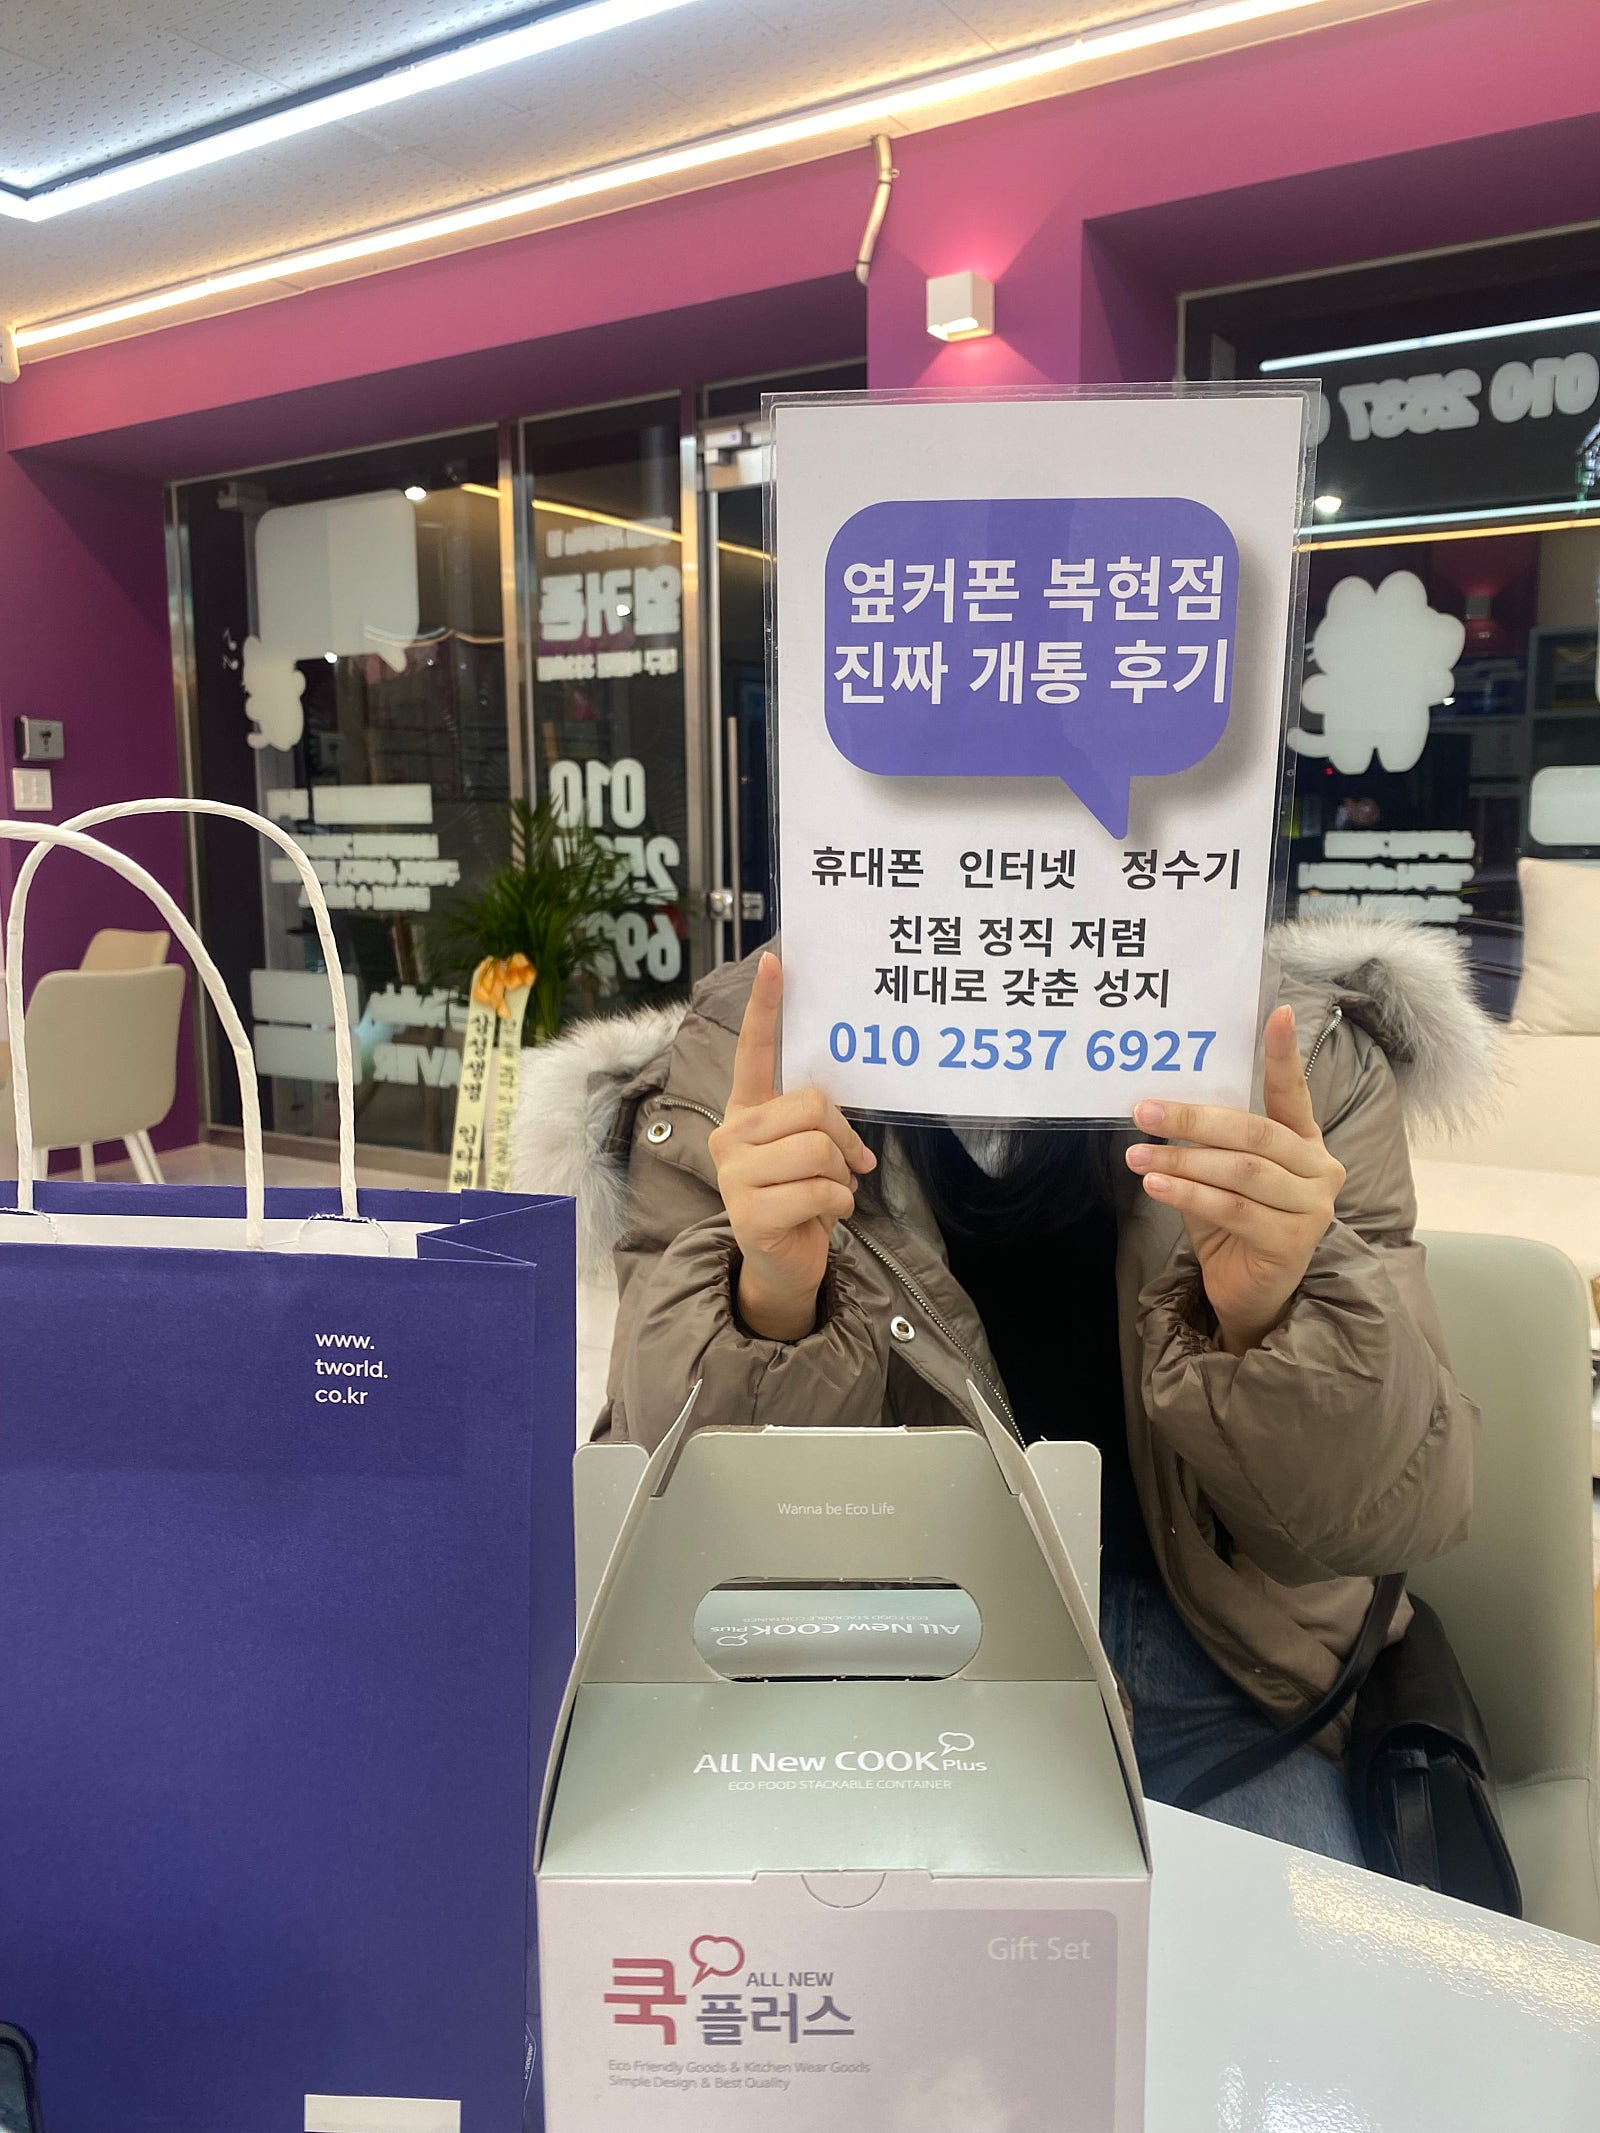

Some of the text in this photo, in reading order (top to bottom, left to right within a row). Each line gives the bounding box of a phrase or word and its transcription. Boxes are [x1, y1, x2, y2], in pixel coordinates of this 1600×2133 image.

[843, 555, 1225, 624] 옆커폰 복현점
[834, 638, 1228, 705] 진짜 개통 후기
[811, 846, 1241, 890] 휴대폰 인터넷 정수기
[889, 914, 1147, 958] 친절 정직 저렴
[874, 965, 1170, 1009] 제대로 갖춘 성지
[829, 1021, 1218, 1073] 010 2537 6927
[315, 1333, 375, 1350] www.
[315, 1358, 389, 1379] tworld.
[315, 1386, 369, 1405] co.kr
[777, 1502, 896, 1515] Wanna be Eco Life
[693, 1750, 987, 1774] All New COOK Plus
[728, 1779, 952, 1791] ECO FOOD STACKABLE CONTAINER
[987, 1936, 1092, 1961] Gift Set
[746, 1971, 834, 1987] ALL NEW
[603, 1957, 687, 2046] 쿡
[696, 1992, 855, 2046] 플러스
[608, 2059, 871, 2075] Eco Friendly Goods & Kitchen Wear Goods
[608, 2075, 791, 2091] Simple Design & Best Quality
